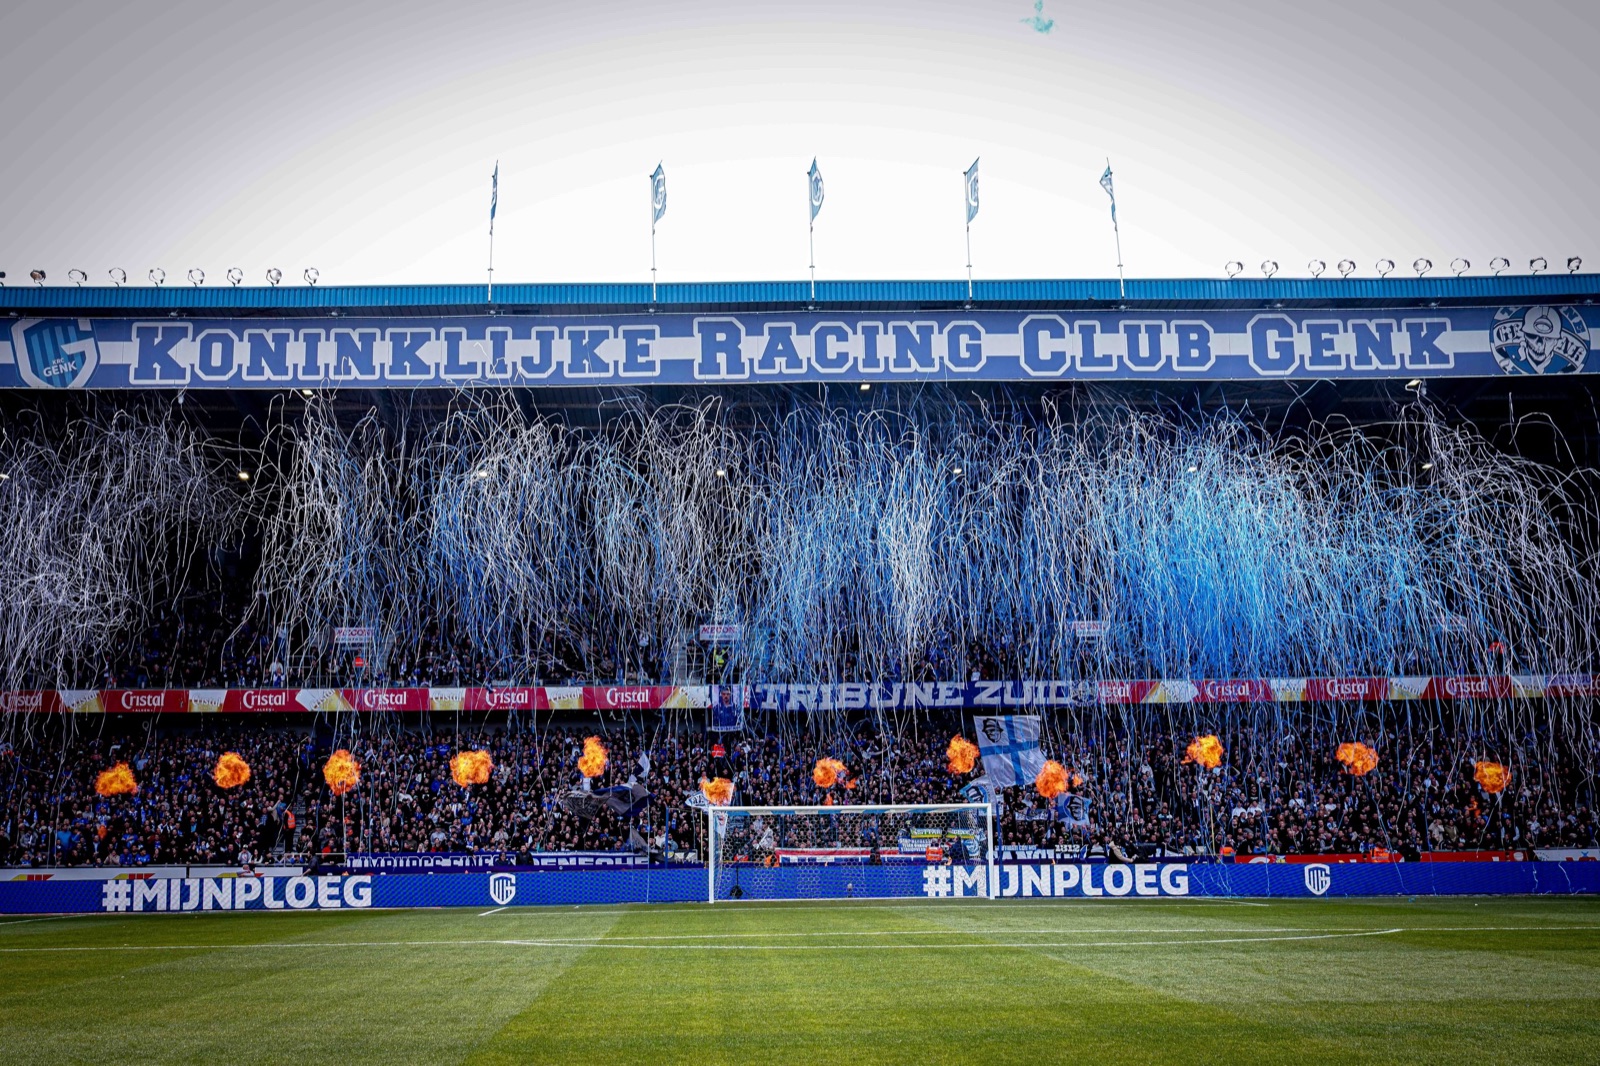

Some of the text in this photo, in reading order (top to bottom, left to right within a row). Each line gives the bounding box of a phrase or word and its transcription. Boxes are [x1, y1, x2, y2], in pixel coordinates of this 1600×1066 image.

[130, 313, 1455, 385] KONINKLIJKE RACING CLUB GENK
[43, 361, 77, 377] GENK
[486, 688, 528, 707] Cristal
[606, 687, 649, 706] Cristal
[755, 680, 1073, 710] TRIBUNE ZUID
[1207, 681, 1250, 699] Cristal
[1326, 679, 1369, 698] Cristal
[1, 691, 43, 710] Cristal
[121, 691, 164, 710] Cristal
[243, 690, 286, 709] Cristal
[364, 689, 407, 708] Cristal
[923, 863, 1189, 897] #MIJNPLOEG
[102, 875, 372, 911] #MIJNPLOEG
